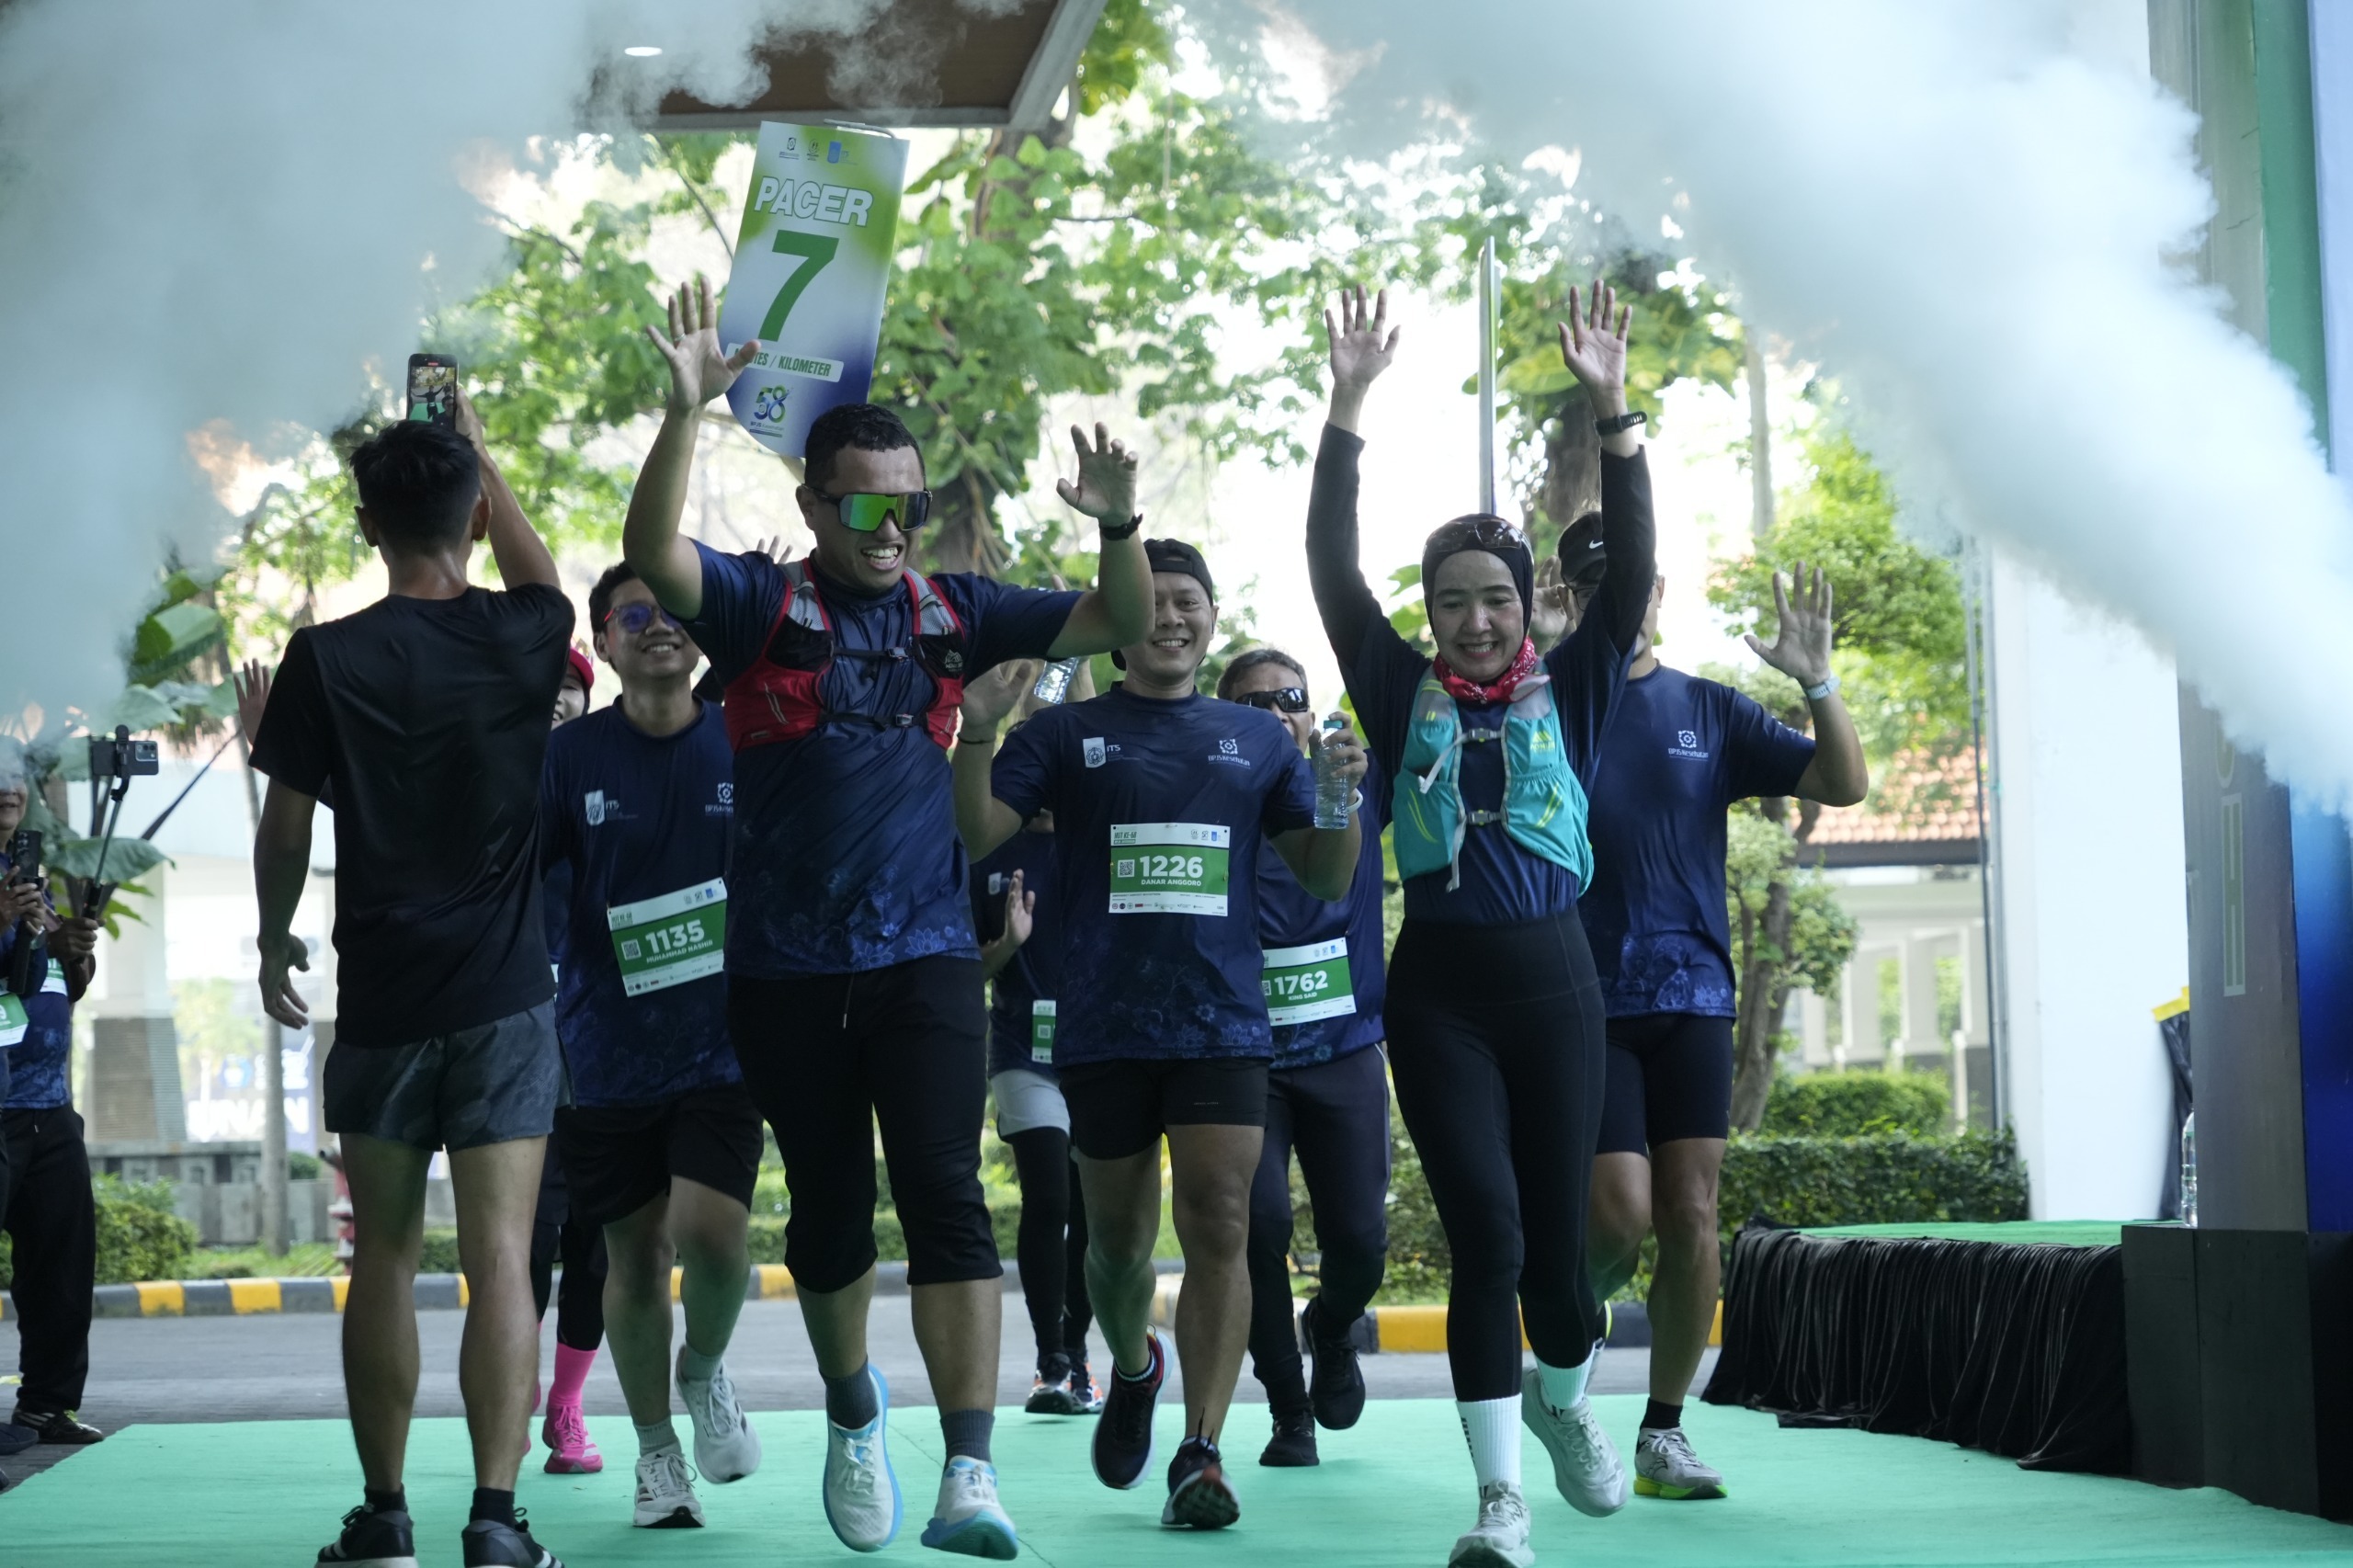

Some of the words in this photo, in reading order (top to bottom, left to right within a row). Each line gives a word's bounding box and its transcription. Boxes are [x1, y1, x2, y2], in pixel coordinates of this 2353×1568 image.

[754, 176, 874, 228] PACER
[757, 229, 840, 342] 7
[778, 356, 832, 377] KILOMETER
[1140, 855, 1203, 879] 1226
[1167, 879, 1202, 887] ANGGORO
[645, 919, 705, 954] 1135
[1274, 970, 1329, 995] 1762
